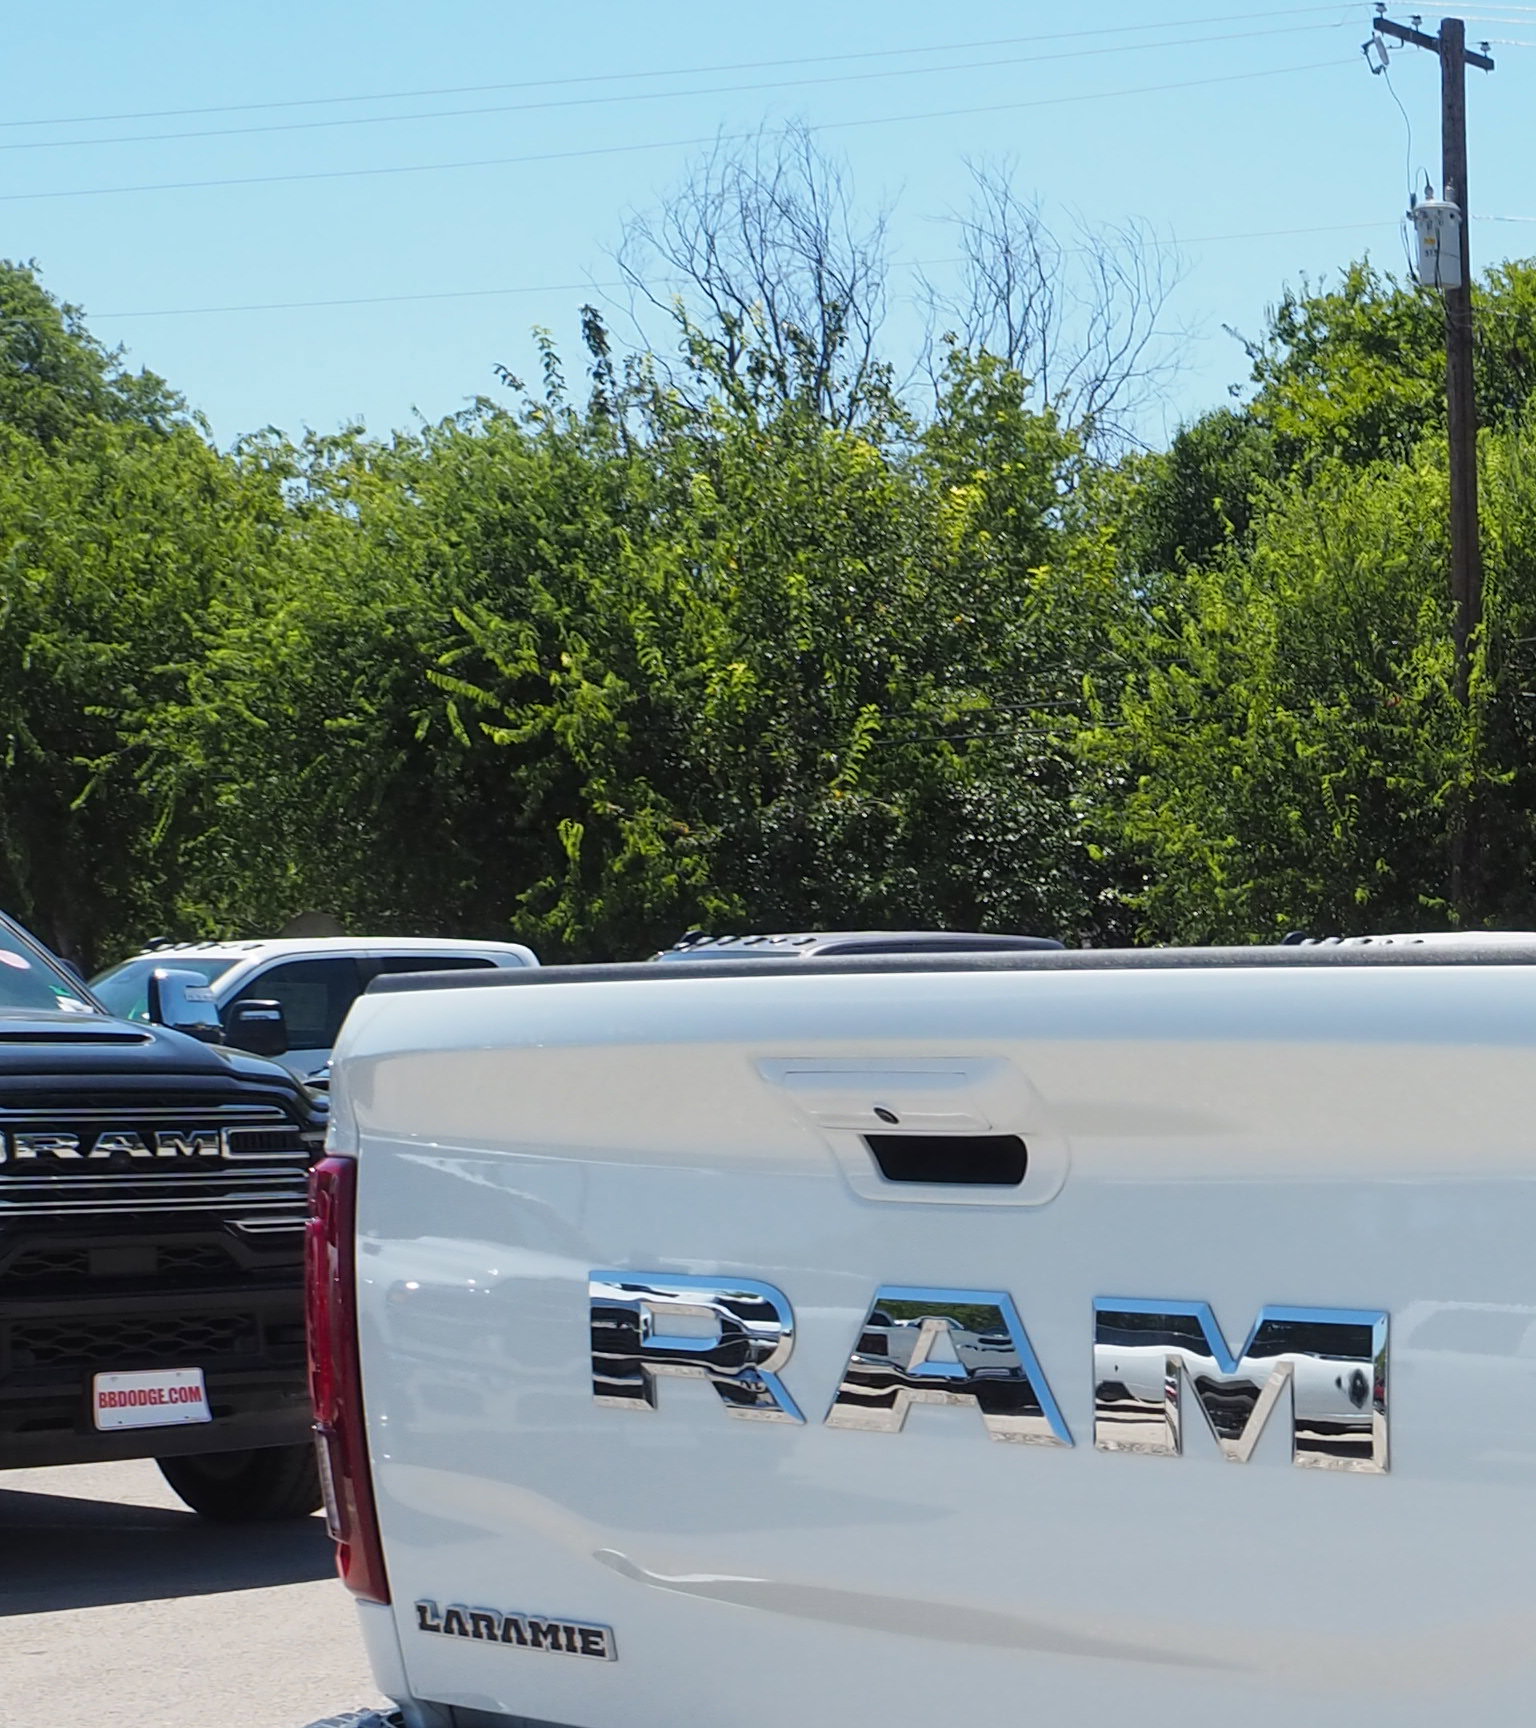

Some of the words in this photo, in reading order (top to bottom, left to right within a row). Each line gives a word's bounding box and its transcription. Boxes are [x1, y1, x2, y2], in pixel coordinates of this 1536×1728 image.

[13, 1130, 220, 1158] RAM
[587, 1269, 1392, 1474] RAM
[98, 1386, 203, 1408] BBDODGE.COM
[414, 1600, 614, 1660] LARAMIE
